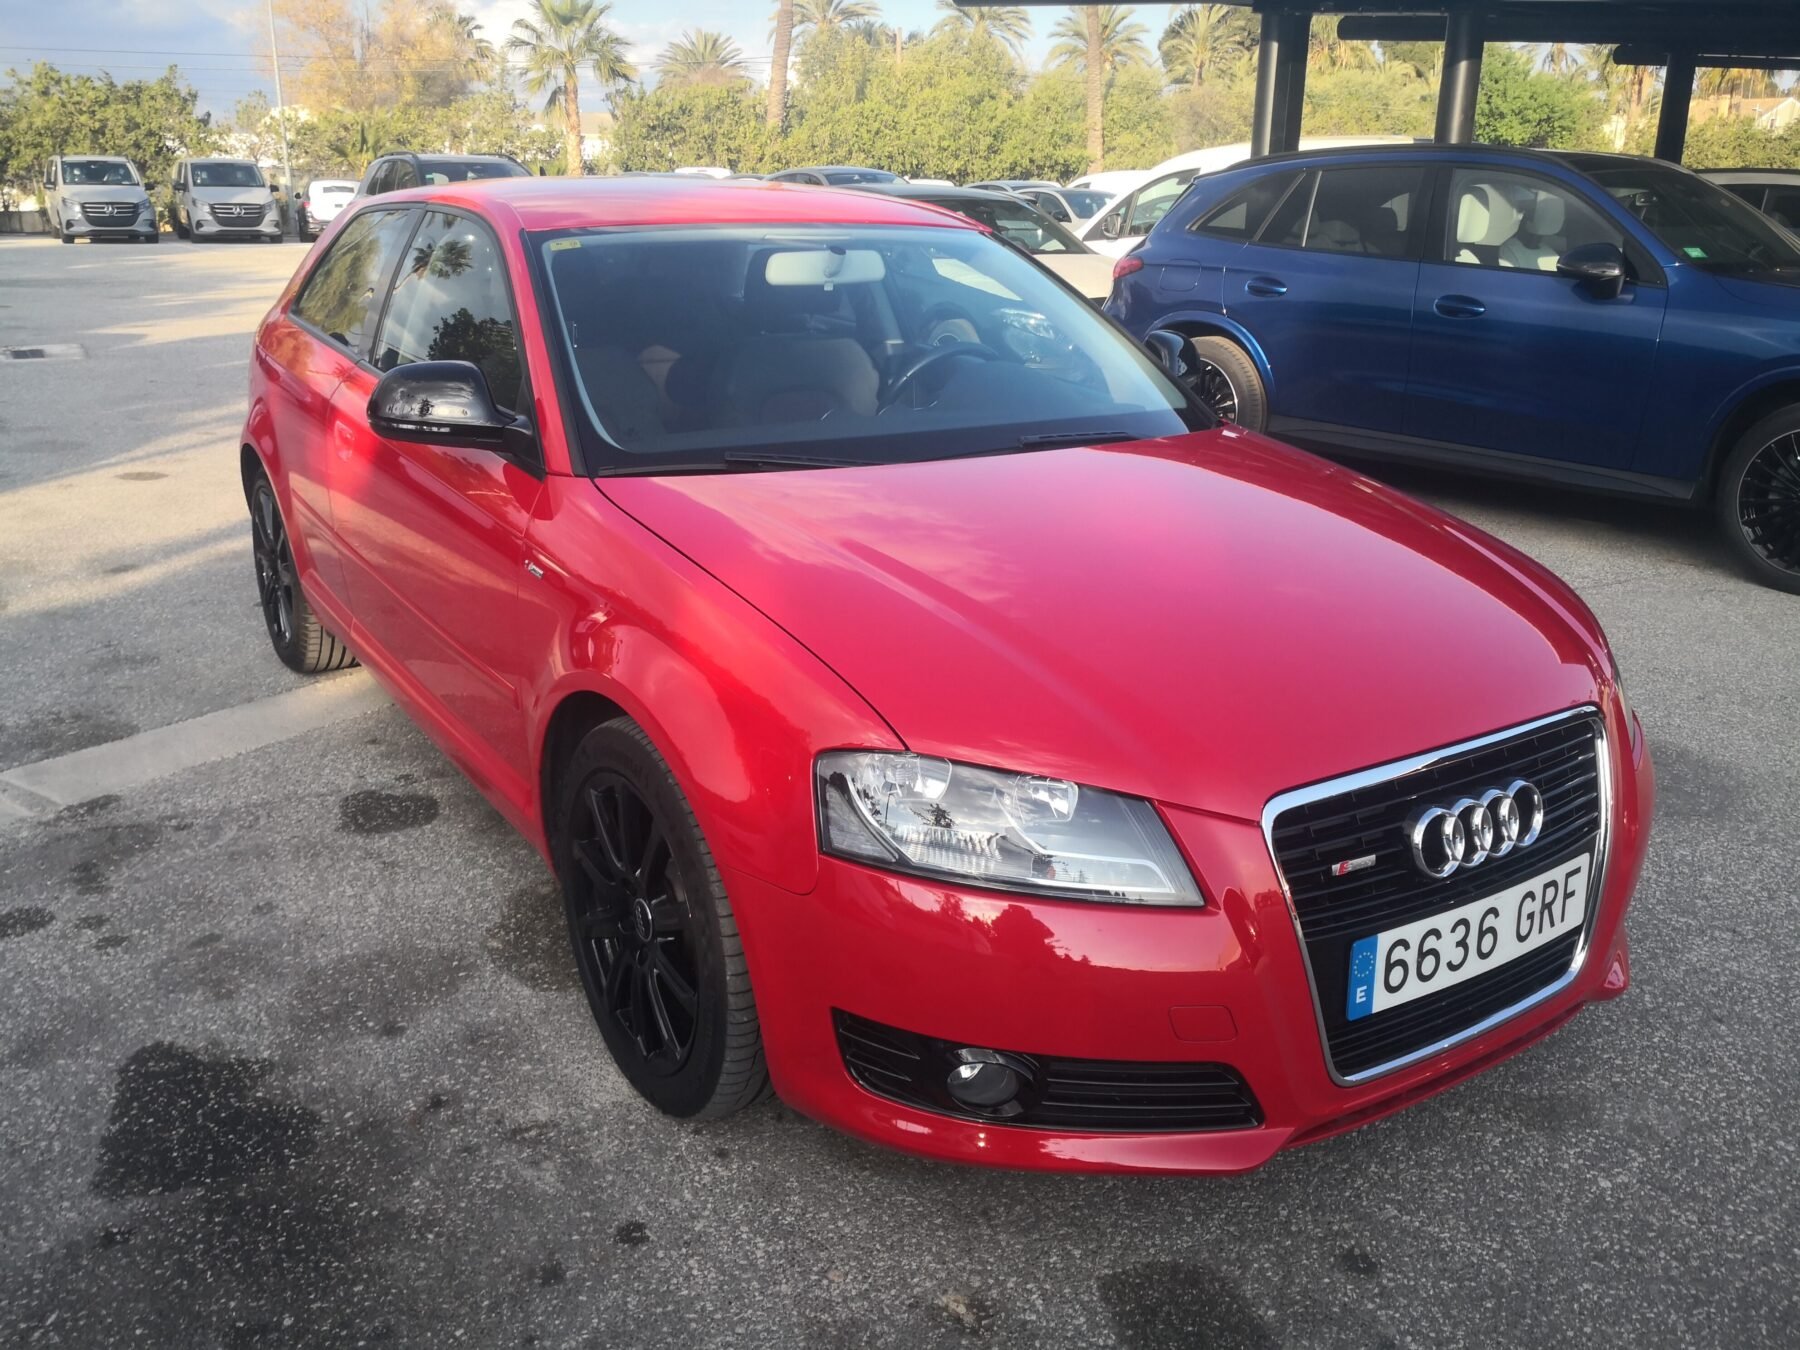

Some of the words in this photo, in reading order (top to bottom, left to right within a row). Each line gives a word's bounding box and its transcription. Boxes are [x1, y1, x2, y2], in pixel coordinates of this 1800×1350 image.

[1383, 907, 1500, 994] 6636
[1515, 866, 1582, 943] GRF
[1355, 985, 1367, 1004] E
